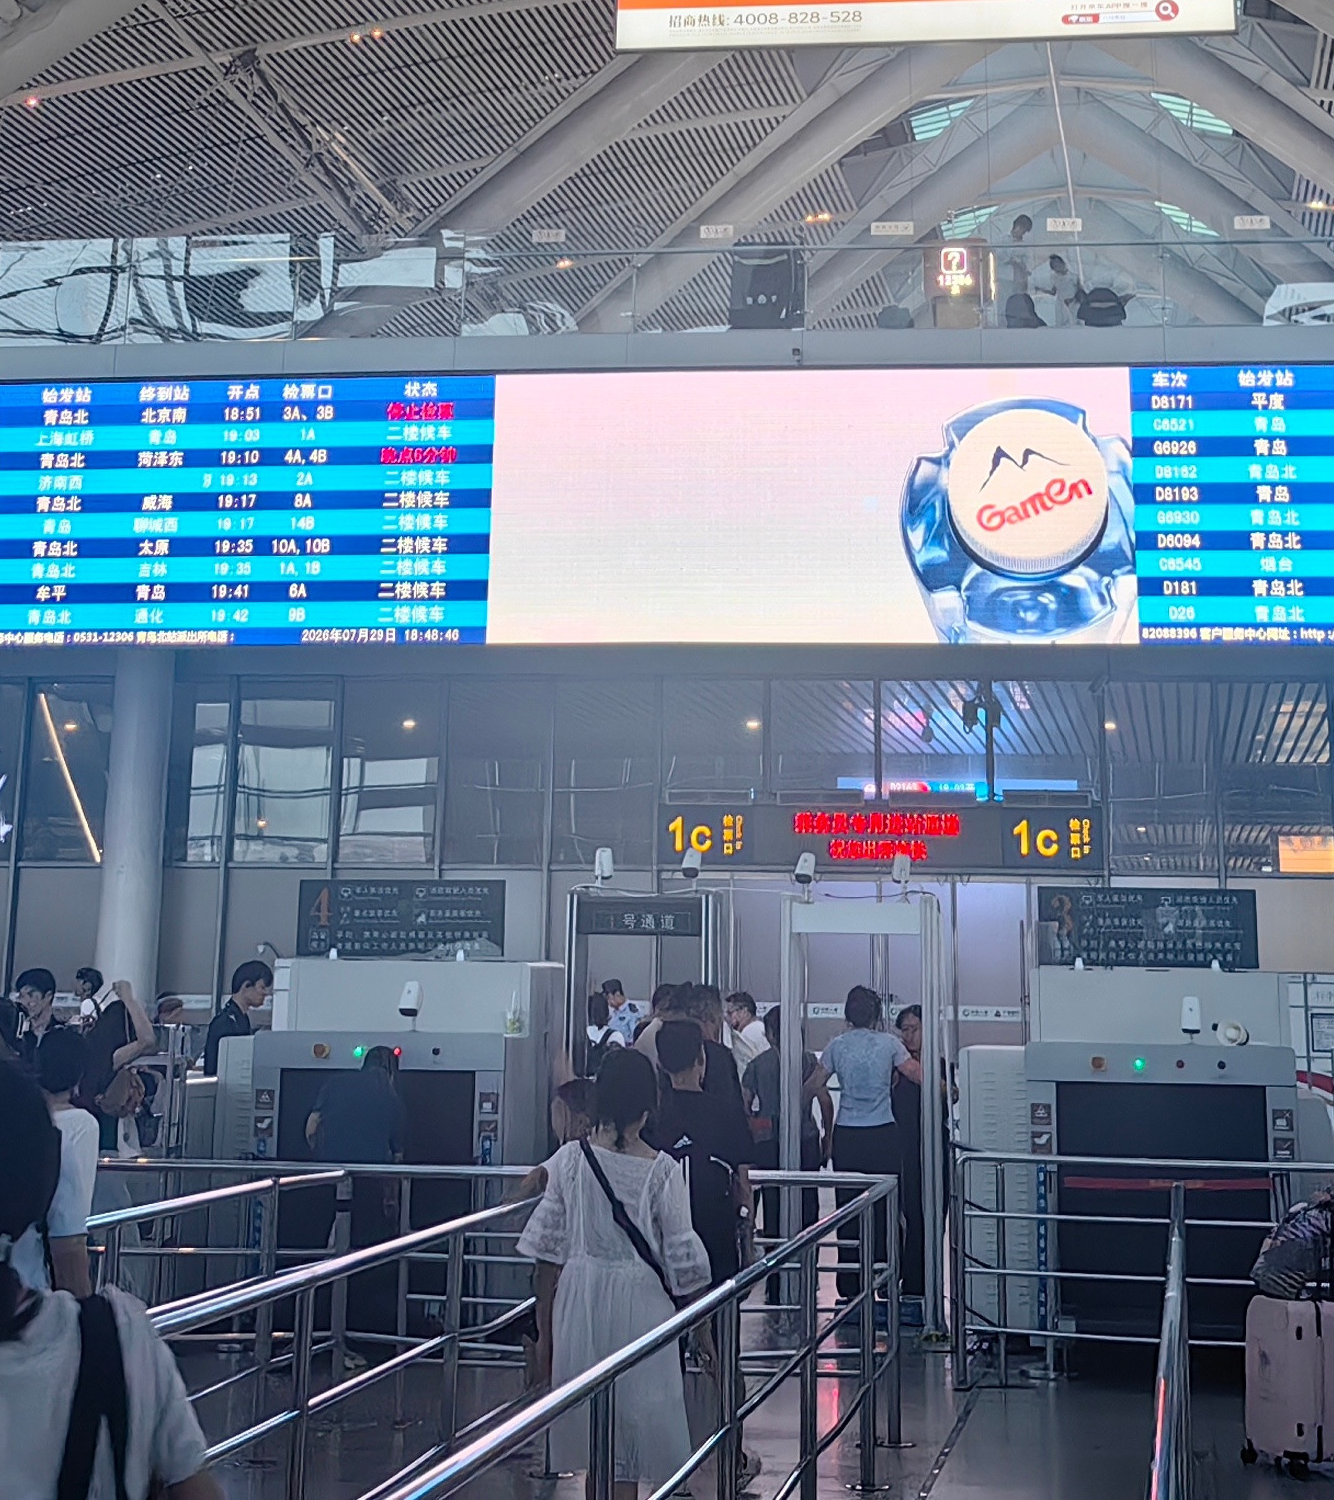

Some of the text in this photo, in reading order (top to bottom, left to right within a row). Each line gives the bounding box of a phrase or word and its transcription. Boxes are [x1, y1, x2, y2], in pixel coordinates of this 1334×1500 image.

[734, 11, 862, 25] 4008-828-528
[1152, 371, 1187, 388] 车次
[1238, 369, 1294, 387] 始发站
[42, 387, 91, 404] 始发站
[139, 385, 189, 402] 终到站
[227, 384, 260, 400] 开点
[283, 384, 332, 400] 检票口
[404, 381, 437, 398] 状态
[1151, 395, 1193, 409] D8171
[1251, 393, 1284, 410] 平度
[44, 409, 88, 425] 青岛北
[141, 407, 187, 423] 北京南
[225, 407, 260, 421] 18:51
[1254, 438, 1287, 456] 青岛
[41, 453, 85, 468] 青岛北
[221, 451, 259, 464] 19:10
[37, 496, 81, 512] 青岛北
[142, 495, 172, 510] 威海
[219, 494, 256, 508] 19:17
[294, 493, 311, 508] 8A
[383, 491, 449, 508] 二楼候车
[1156, 487, 1198, 501] D8193
[1256, 485, 1290, 502] 青岛
[33, 541, 77, 557] 青岛北
[139, 539, 169, 555] 太原
[215, 539, 253, 553] 19:35
[381, 536, 448, 554] 二楼候车
[1250, 532, 1301, 549] 青岛北
[36, 585, 66, 601] 牟平
[136, 584, 165, 600] 青岛
[212, 584, 248, 598] 19:41
[289, 583, 307, 598] 6A
[378, 581, 446, 599] 二楼候车
[1164, 581, 1196, 595] D181
[1252, 579, 1303, 597] 青岛北
[302, 628, 395, 644] 2026年07月29日
[405, 629, 459, 642] 18:48:46
